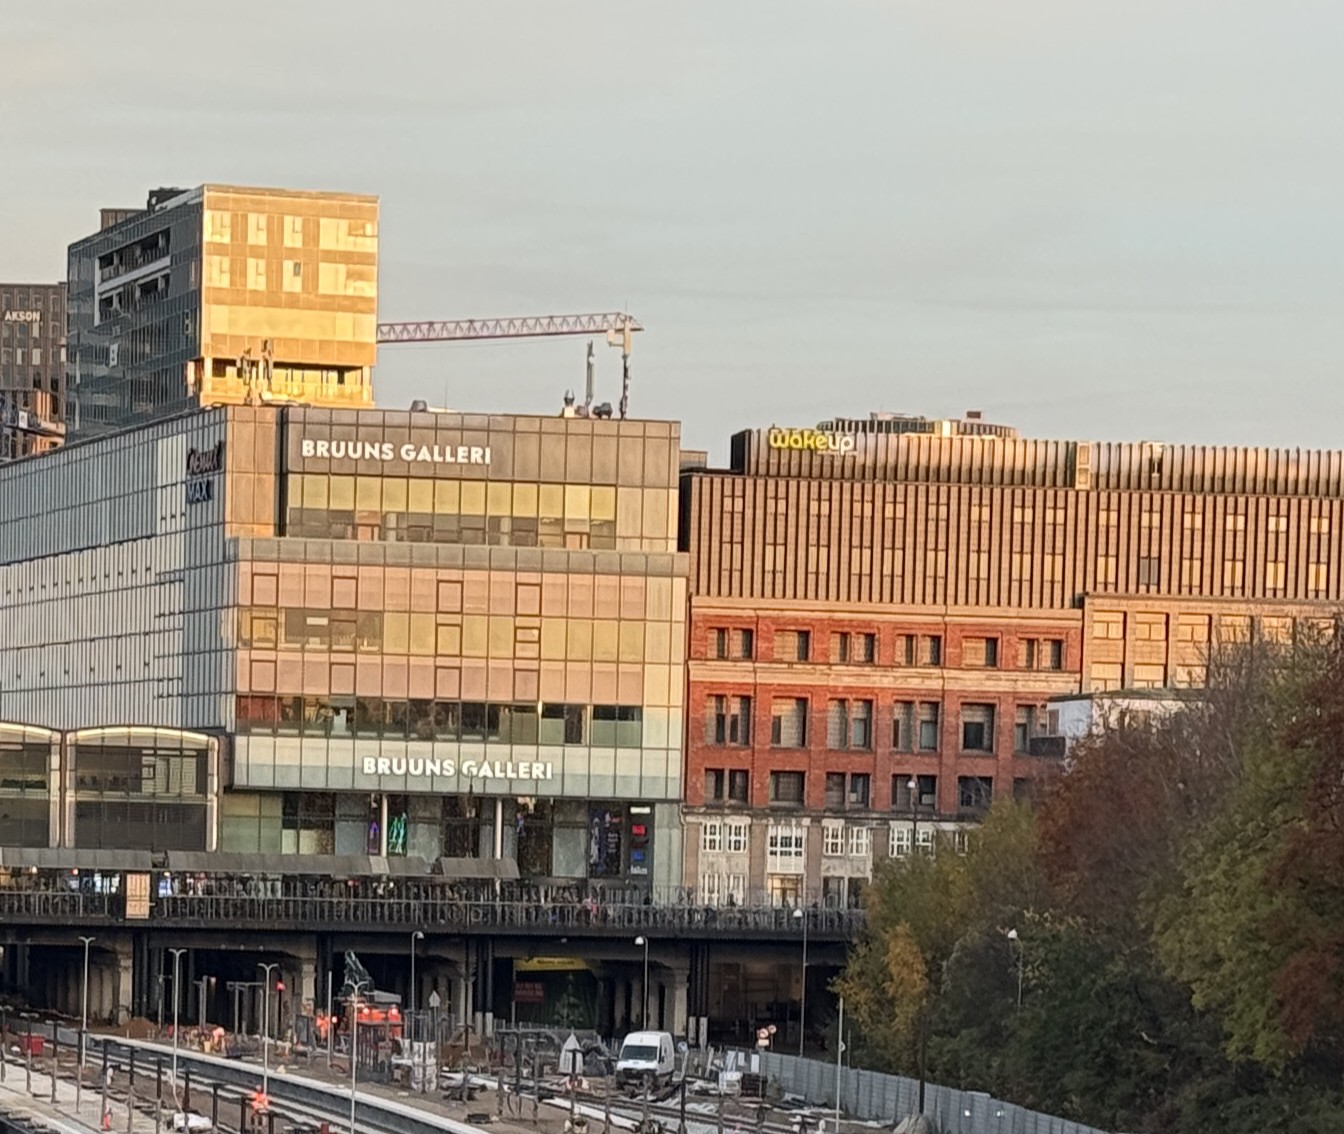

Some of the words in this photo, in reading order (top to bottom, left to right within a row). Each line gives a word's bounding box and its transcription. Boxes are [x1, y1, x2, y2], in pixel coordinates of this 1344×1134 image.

[4, 310, 41, 321] AKSON
[301, 438, 394, 461] BRUUNS
[400, 443, 491, 465] GALLERI
[362, 756, 455, 777] BRUUNS
[461, 759, 552, 780] GALLERI
